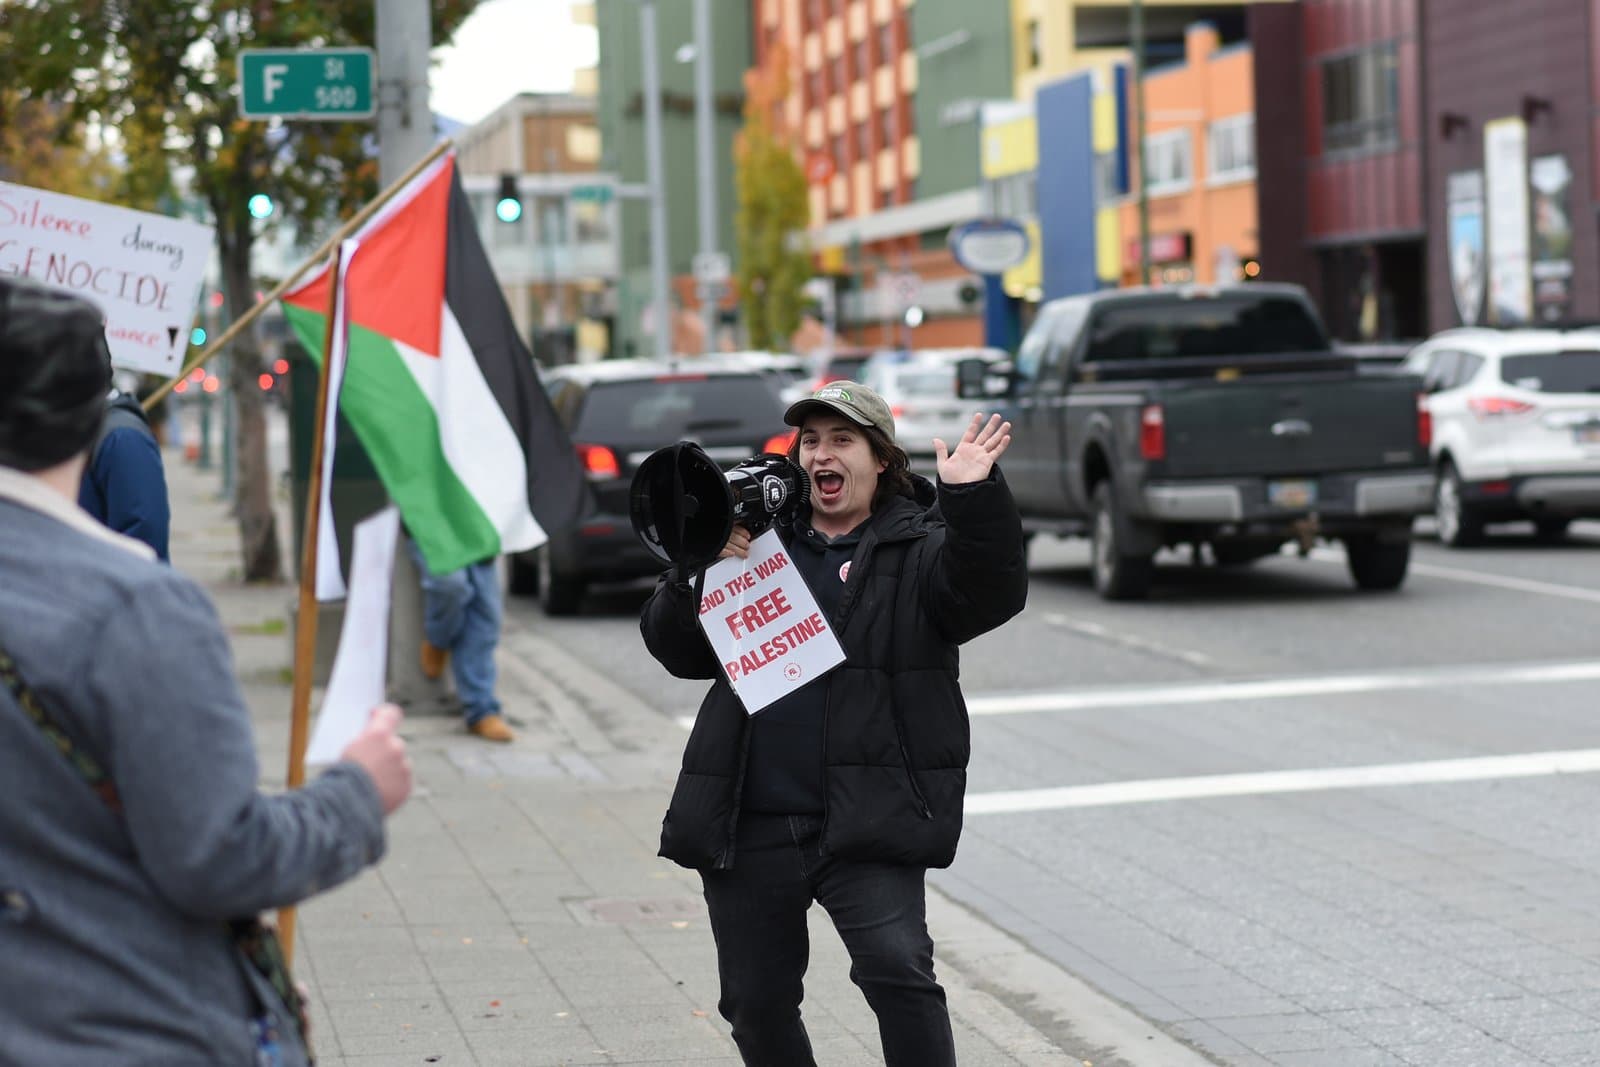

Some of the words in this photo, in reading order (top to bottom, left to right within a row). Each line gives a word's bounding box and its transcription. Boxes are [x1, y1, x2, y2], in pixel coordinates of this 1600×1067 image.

[263, 64, 289, 104] F
[324, 57, 345, 80] St
[315, 85, 357, 109] 500
[0, 190, 92, 238] Silence
[122, 222, 185, 270] during
[699, 589, 726, 616] END
[724, 571, 756, 597] THE
[754, 551, 789, 580] WAR
[725, 587, 793, 641] FREE
[724, 612, 826, 682] PALESTINE
